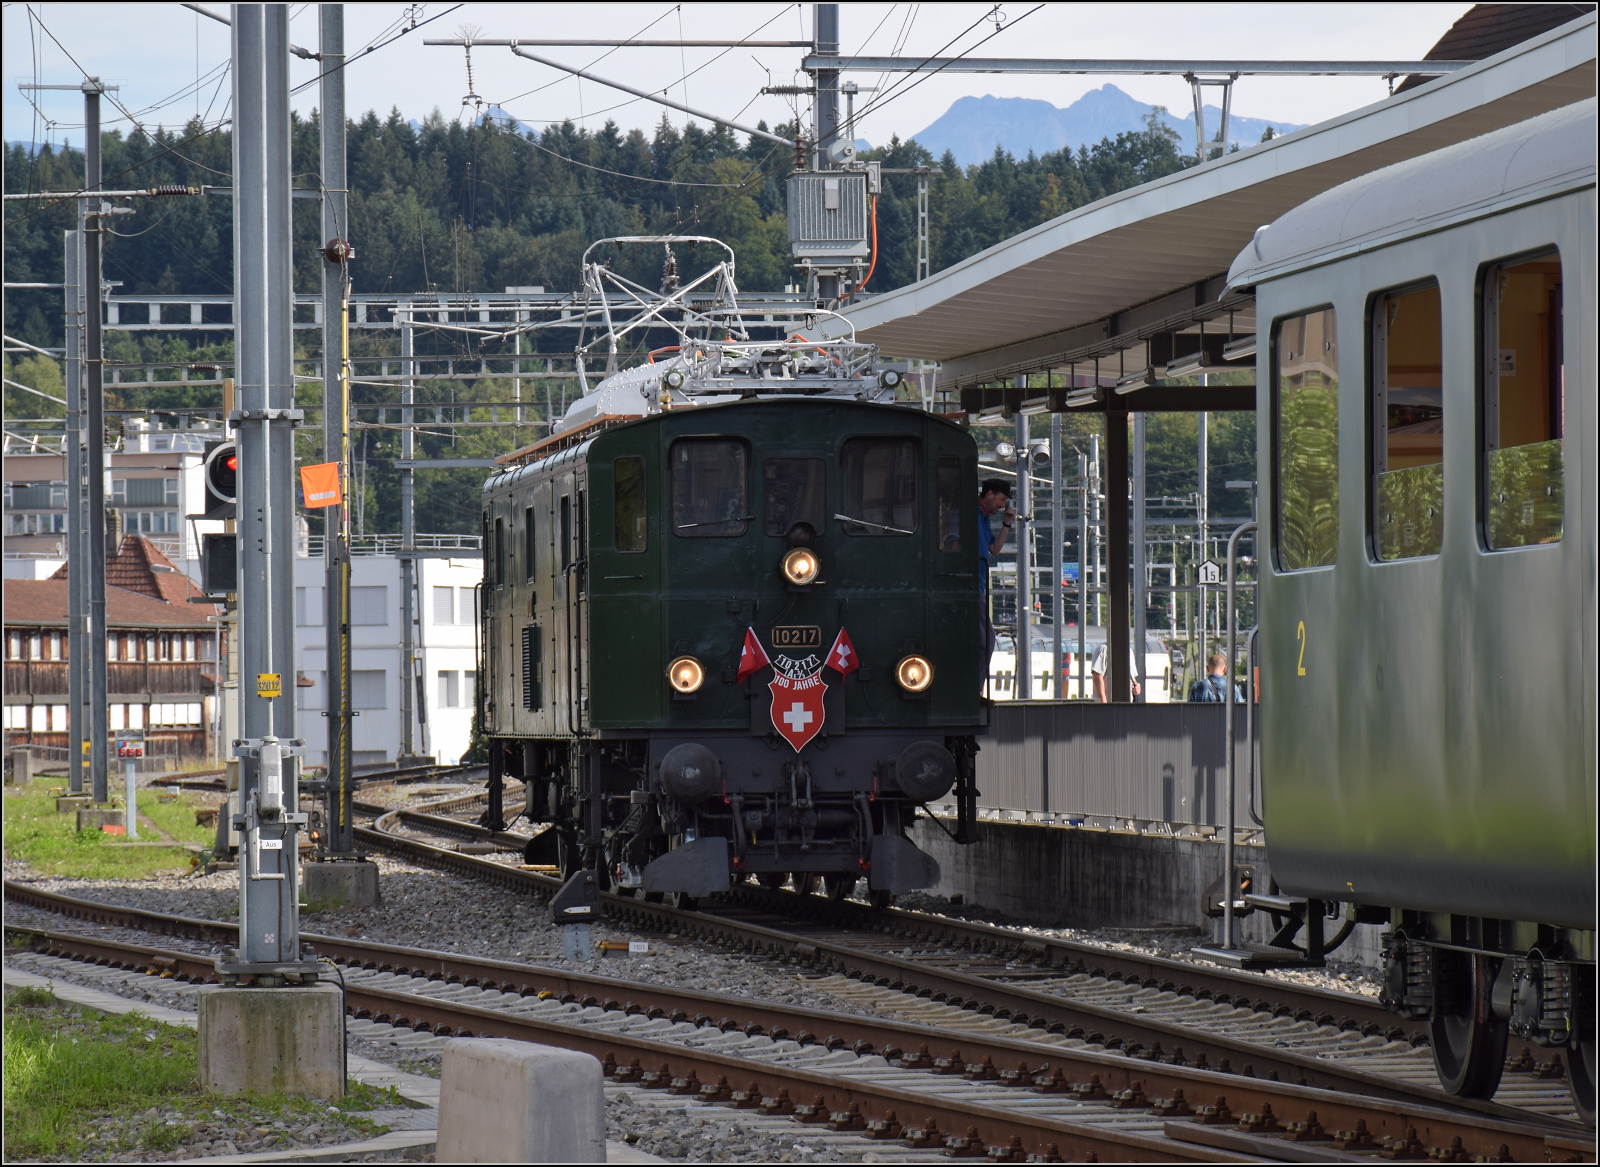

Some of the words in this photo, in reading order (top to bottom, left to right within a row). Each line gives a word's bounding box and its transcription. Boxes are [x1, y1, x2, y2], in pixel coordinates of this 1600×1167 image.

[776, 629, 817, 644] 10217
[1297, 620, 1306, 676] 2
[774, 675, 790, 689] 100
[792, 675, 820, 690] JAHRE
